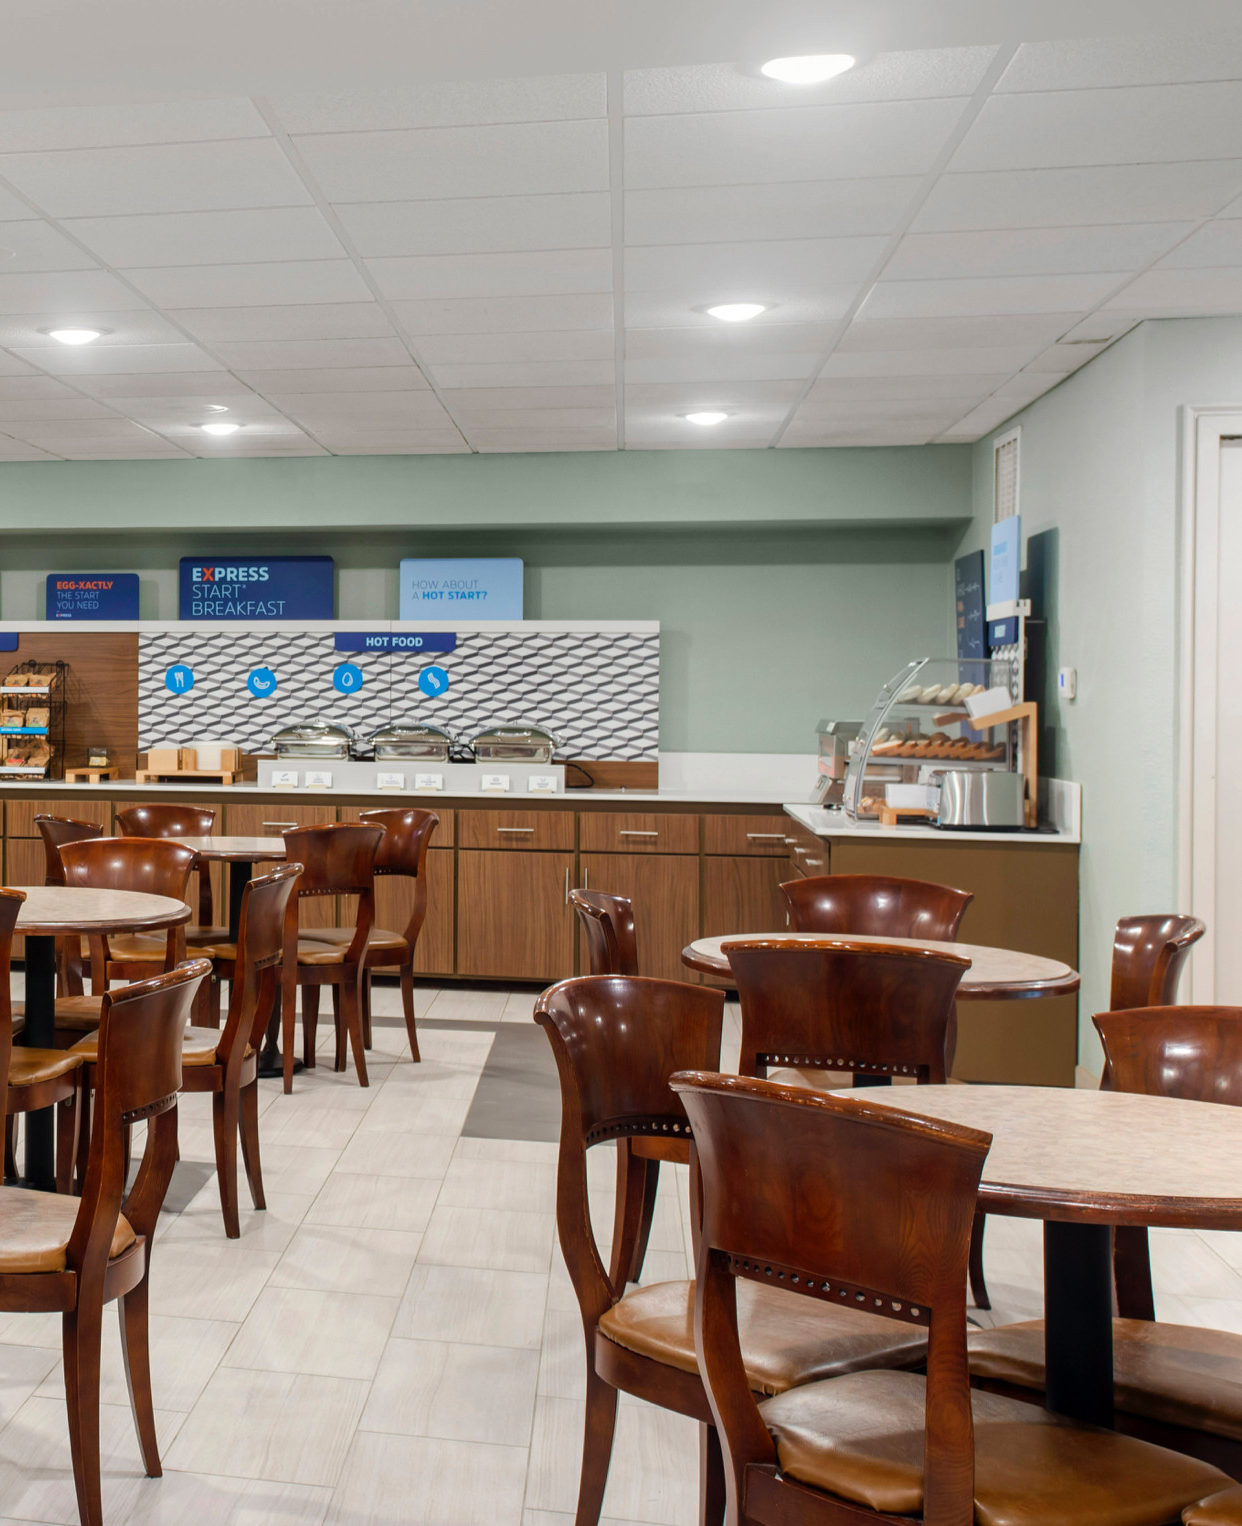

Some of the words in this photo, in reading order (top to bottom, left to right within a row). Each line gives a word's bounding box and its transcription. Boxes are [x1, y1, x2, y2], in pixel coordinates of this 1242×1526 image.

[192, 567, 269, 582] EXPRESS
[56, 581, 113, 590] EGG-XACTLY
[412, 580, 438, 589] HOW
[443, 580, 478, 589] ABOUT
[75, 591, 100, 600] START
[192, 584, 241, 599] START
[412, 592, 419, 600] A
[423, 592, 444, 600] HOT
[448, 591, 487, 600] START?
[57, 601, 74, 609] YOU
[77, 601, 99, 609] NEED
[192, 601, 286, 616] BREAKFAST
[366, 637, 389, 646] HOT
[392, 637, 423, 646] FOOD
